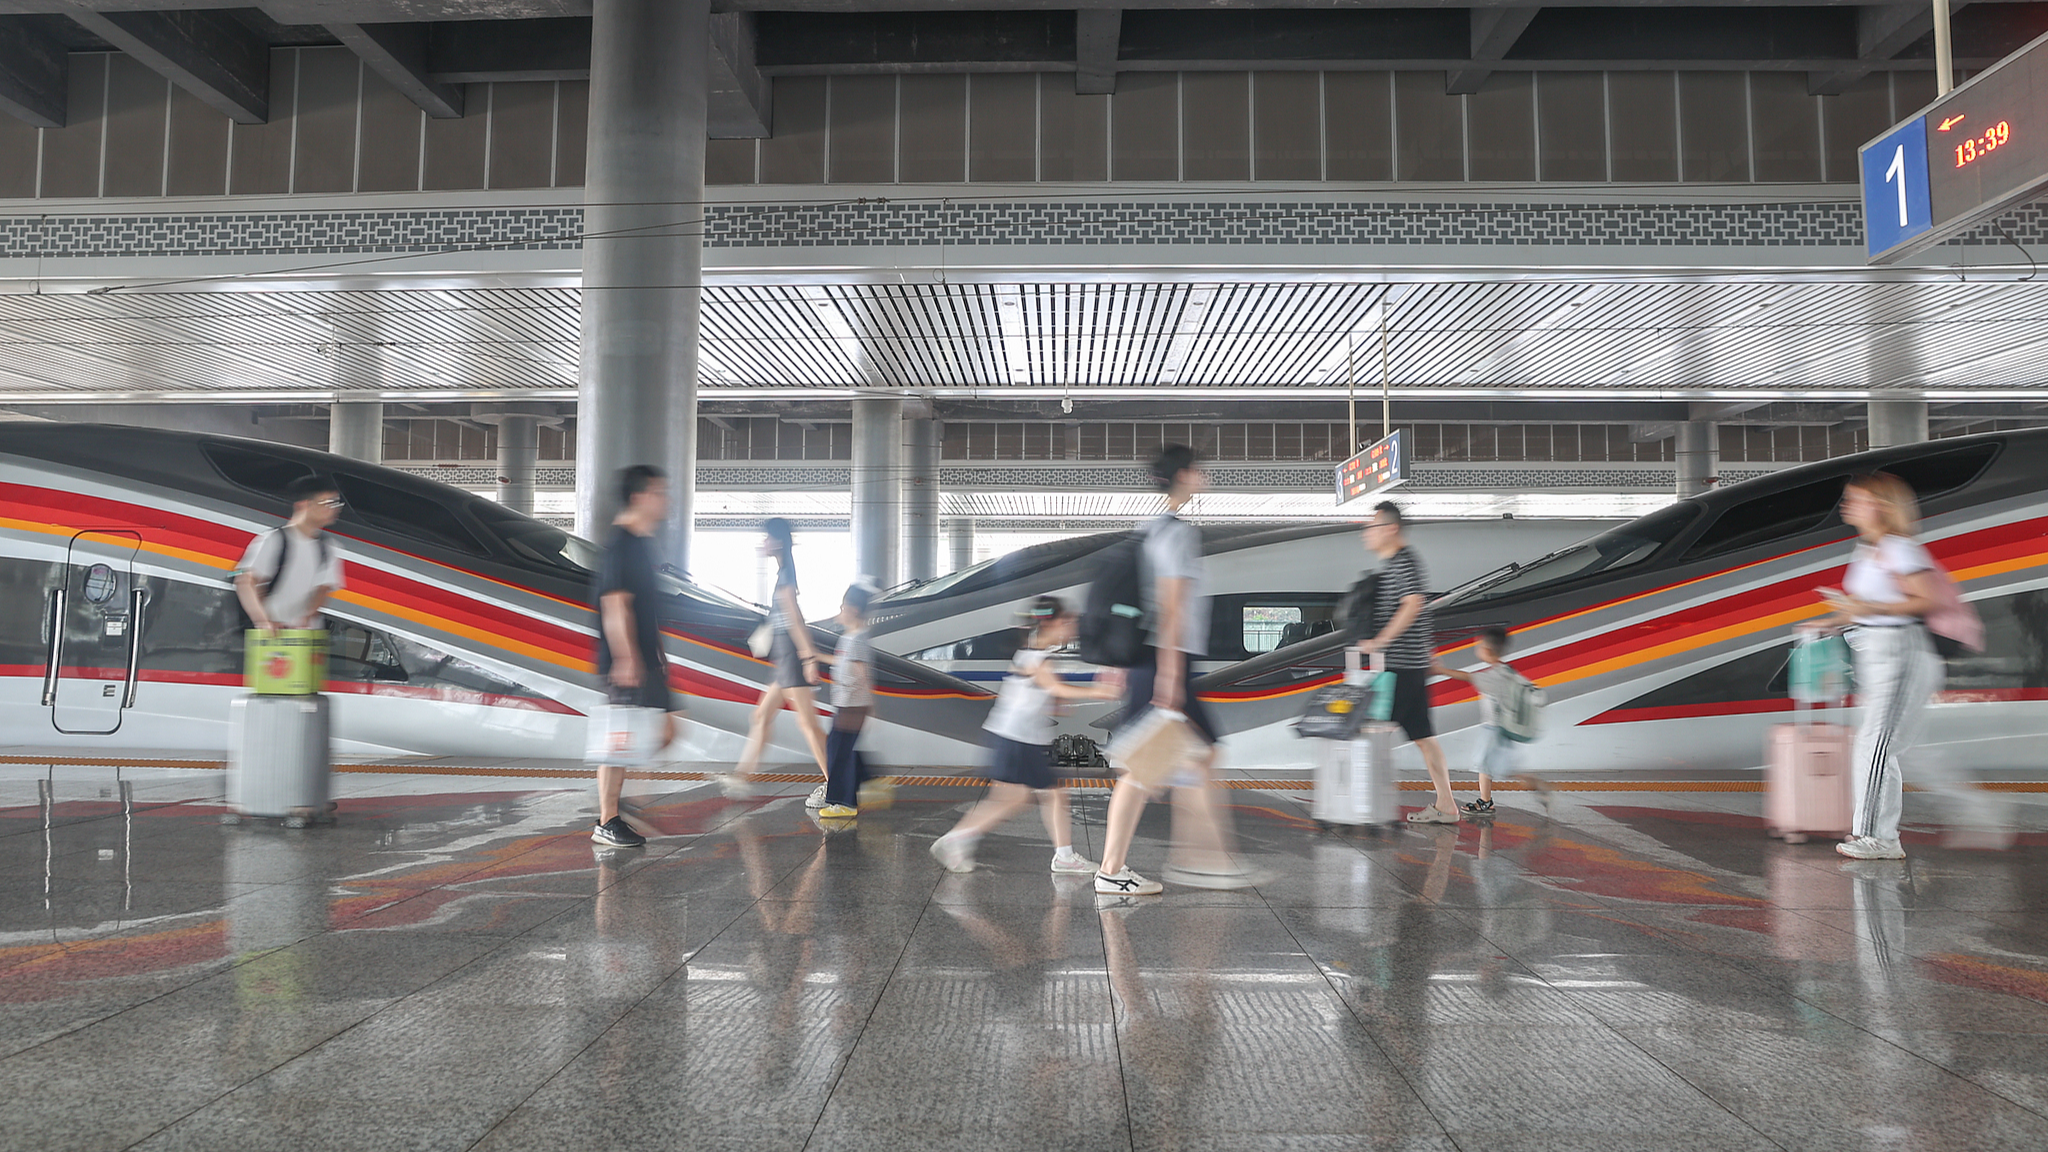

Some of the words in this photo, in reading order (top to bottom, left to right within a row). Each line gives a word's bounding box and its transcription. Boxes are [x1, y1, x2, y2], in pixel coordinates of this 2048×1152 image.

[1955, 120, 2010, 168] 13:39
[1885, 144, 1908, 227] 1
[1391, 440, 1398, 475] 2
[1337, 470, 1343, 500] 3
